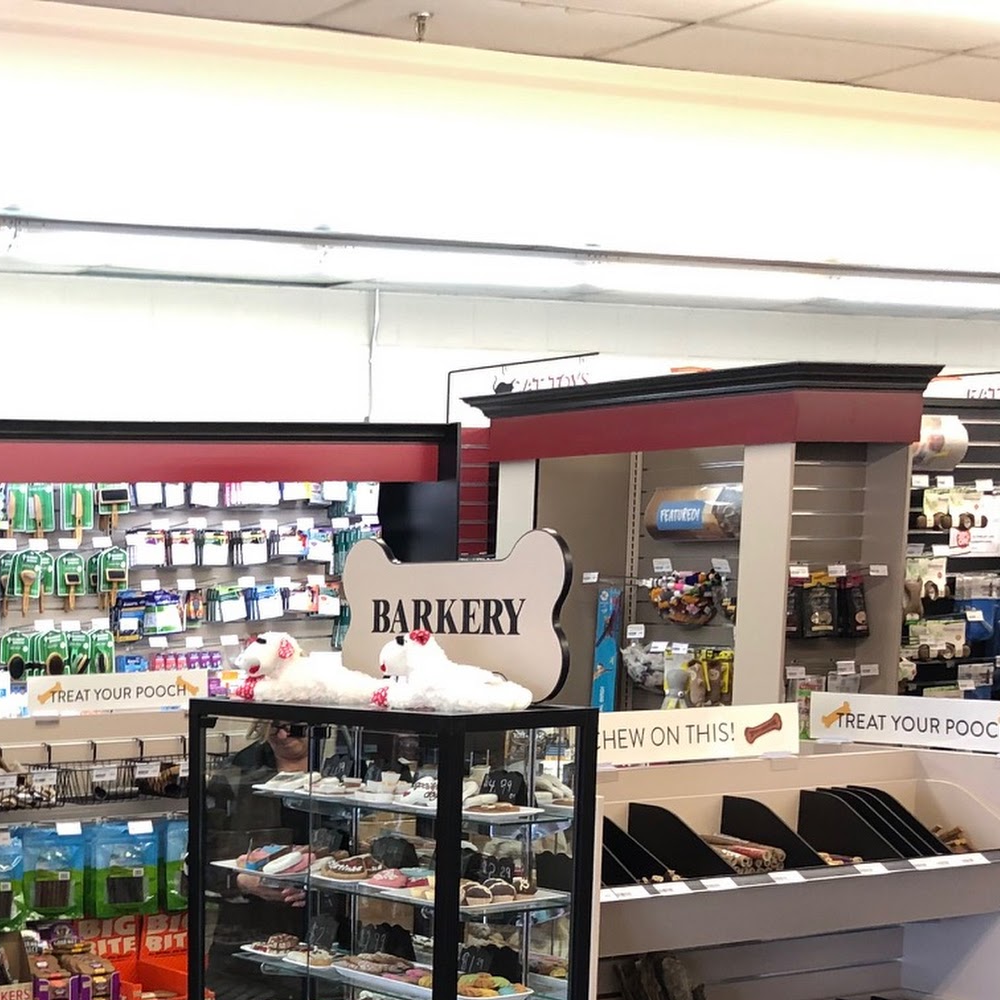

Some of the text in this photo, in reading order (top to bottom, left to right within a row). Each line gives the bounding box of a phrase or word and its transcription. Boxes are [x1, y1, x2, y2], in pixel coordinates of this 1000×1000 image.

[371, 598, 526, 635] BARKERY
[50, 683, 187, 703] TREAT YOUR POOCH
[836, 711, 885, 731] TREAT
[888, 714, 940, 734] YOUR
[650, 725, 681, 747] ON
[687, 722, 735, 744] THIS!
[79, 915, 137, 938] BIG
[146, 914, 188, 935] BI
